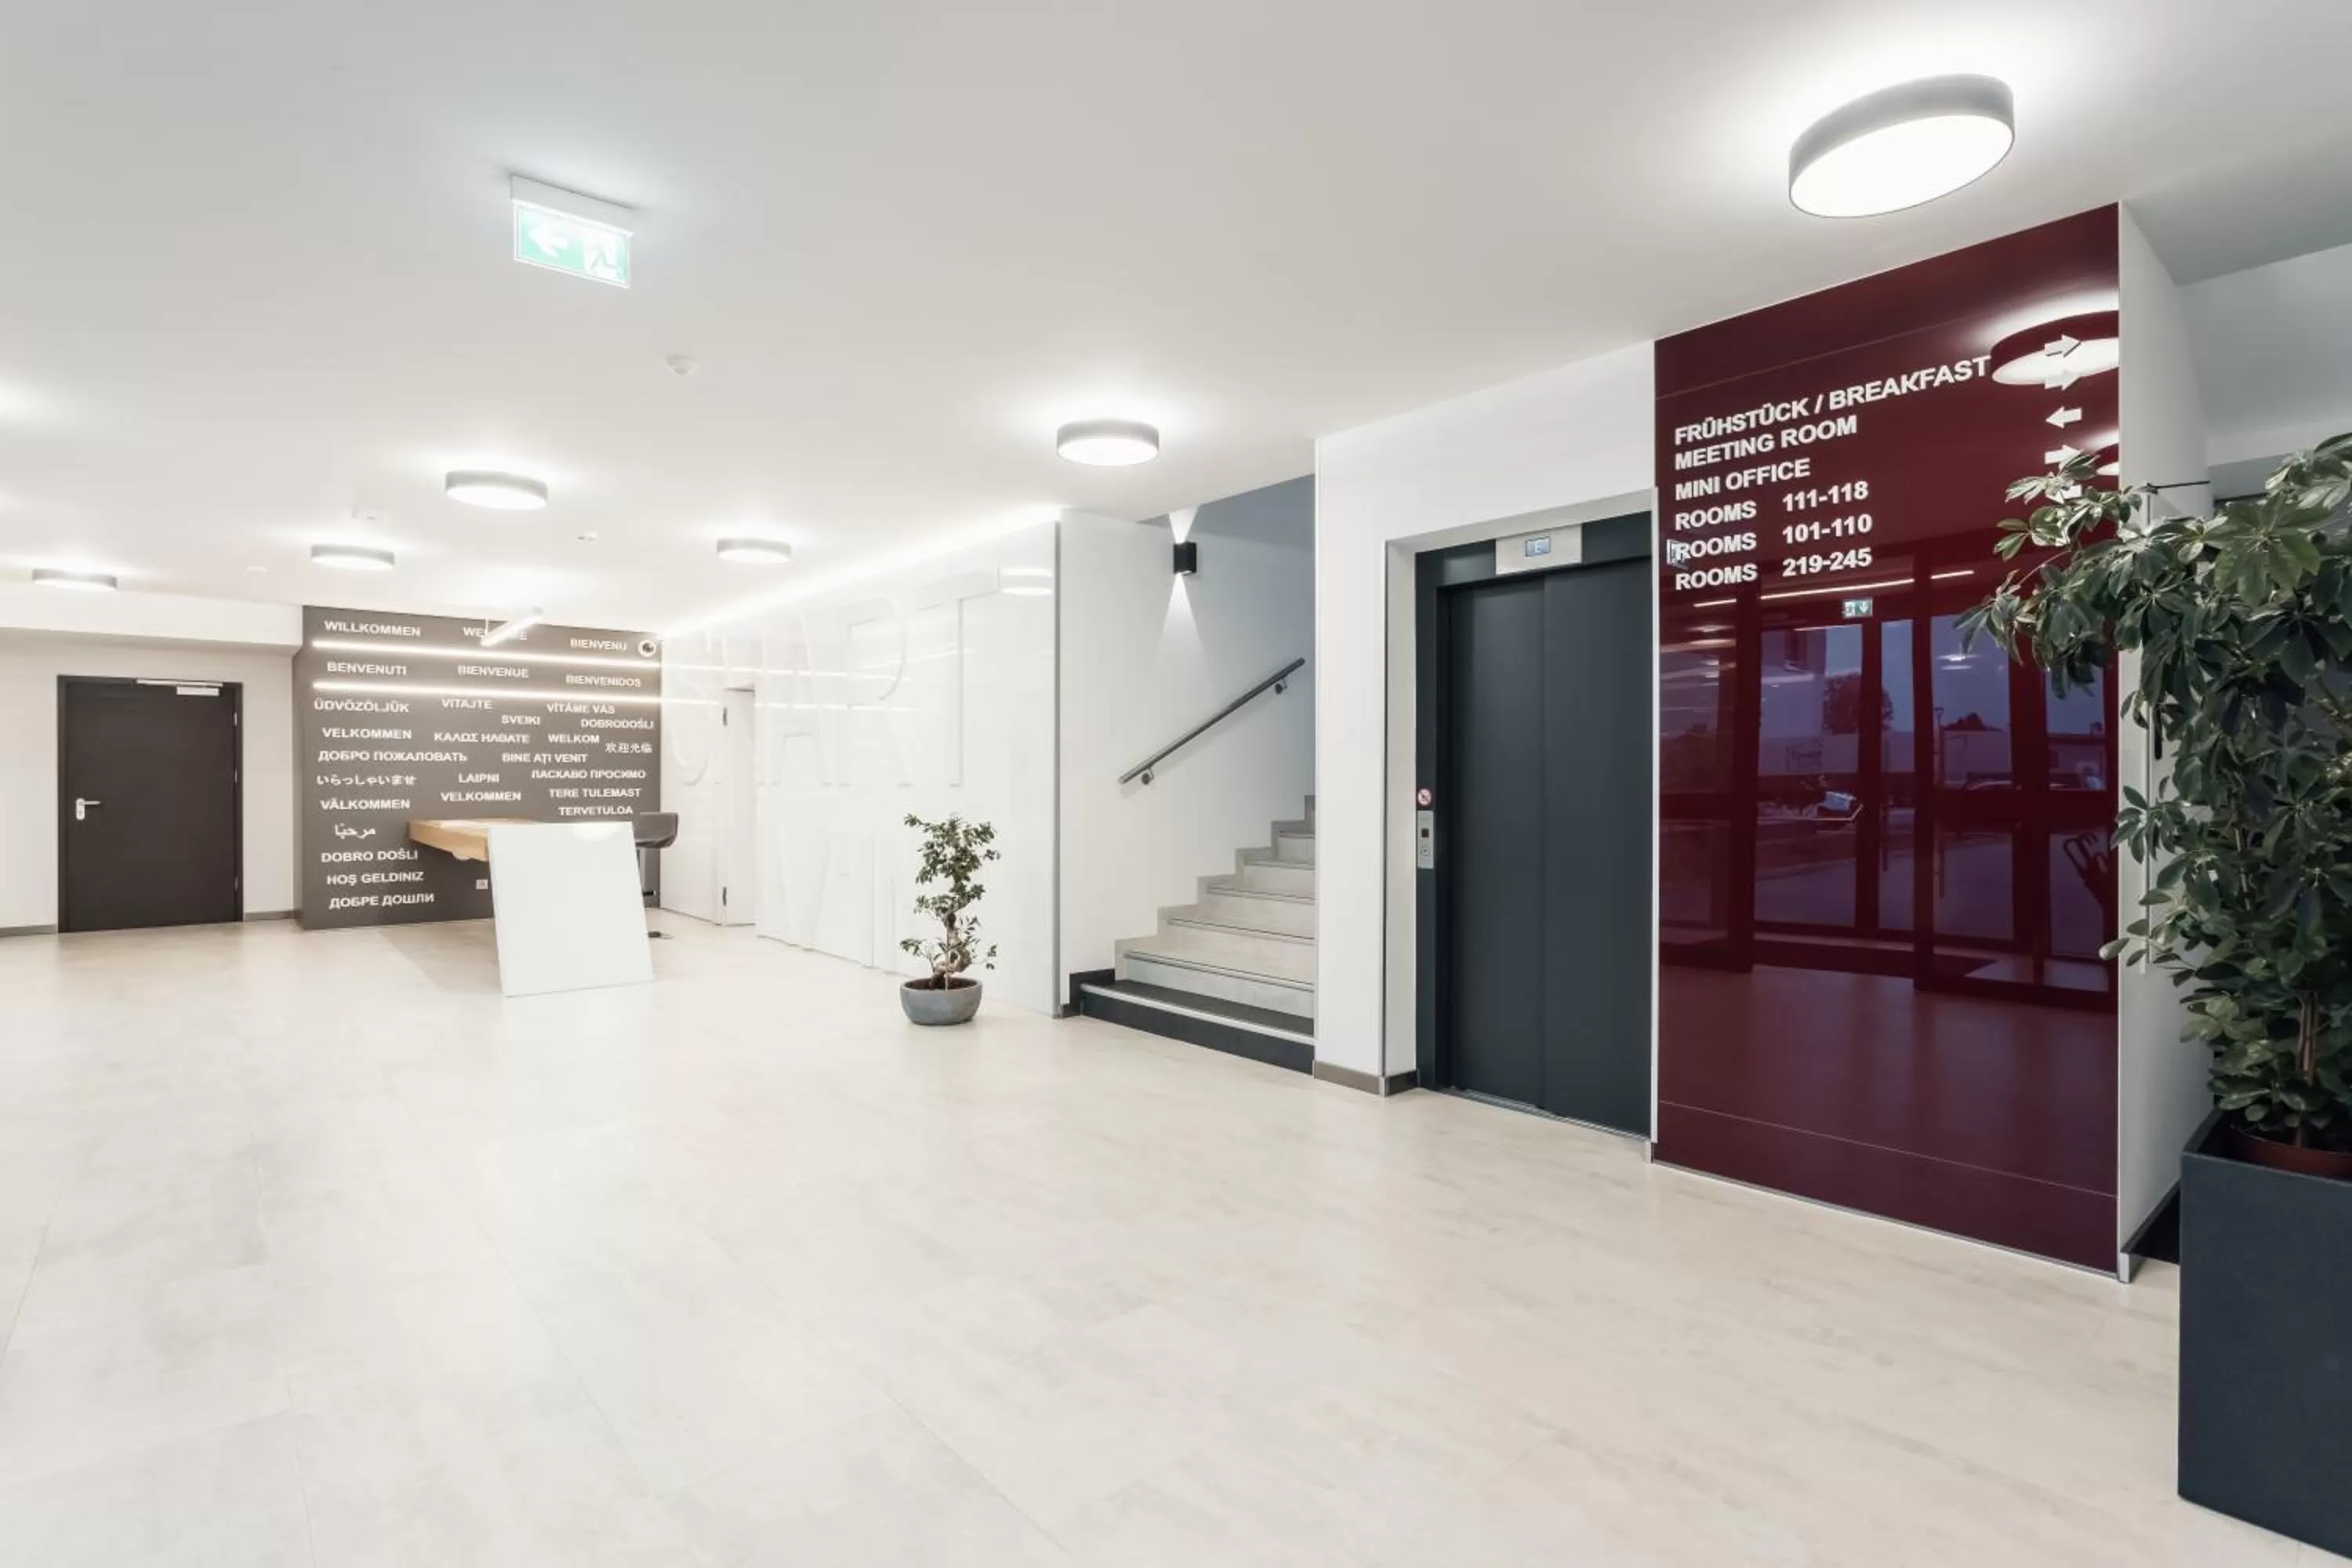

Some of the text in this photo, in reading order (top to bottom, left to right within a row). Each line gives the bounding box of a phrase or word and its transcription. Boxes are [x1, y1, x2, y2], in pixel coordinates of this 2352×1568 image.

[1675, 355, 1991, 445] FRÜHSTÜCK / BREAKFAST
[1675, 415, 1857, 470] MEETING ROOM
[1675, 458, 1810, 501] MINI OFFICE
[1675, 481, 1868, 530] ROOMS 111-118
[1675, 514, 1872, 560] ROOMS 101-110
[1675, 547, 1872, 590] ROOMS 219-245
[324, 620, 421, 637] WILLKOMMEN
[570, 637, 627, 652] BIENVENU
[327, 661, 407, 676] BENVENUTI
[458, 665, 529, 678] BIENVENUE
[565, 674, 642, 688] BIENVENIDOS
[441, 699, 493, 710] VITAJTE
[501, 714, 540, 726] SVEIKI
[321, 727, 412, 740] VELKOMMEN
[548, 733, 599, 744] WELKOM
[318, 750, 467, 764] ДОБРО ПОЖАЛОВАТЬ
[502, 753, 531, 763] BINE
[554, 753, 588, 763] VENIT
[316, 775, 416, 786] いらっしゃいませ
[458, 773, 499, 784] LAIPNI
[531, 769, 647, 779] ЛАСКАВО ПРОСИМО
[441, 791, 521, 802] VELKOMMEN
[549, 787, 642, 798] TERE TULEMAST
[558, 805, 633, 816] TERVETULOA
[321, 848, 418, 863] DOBRO DOŠLI
[328, 892, 434, 909] ДОБРЕ ДОШЛИ
